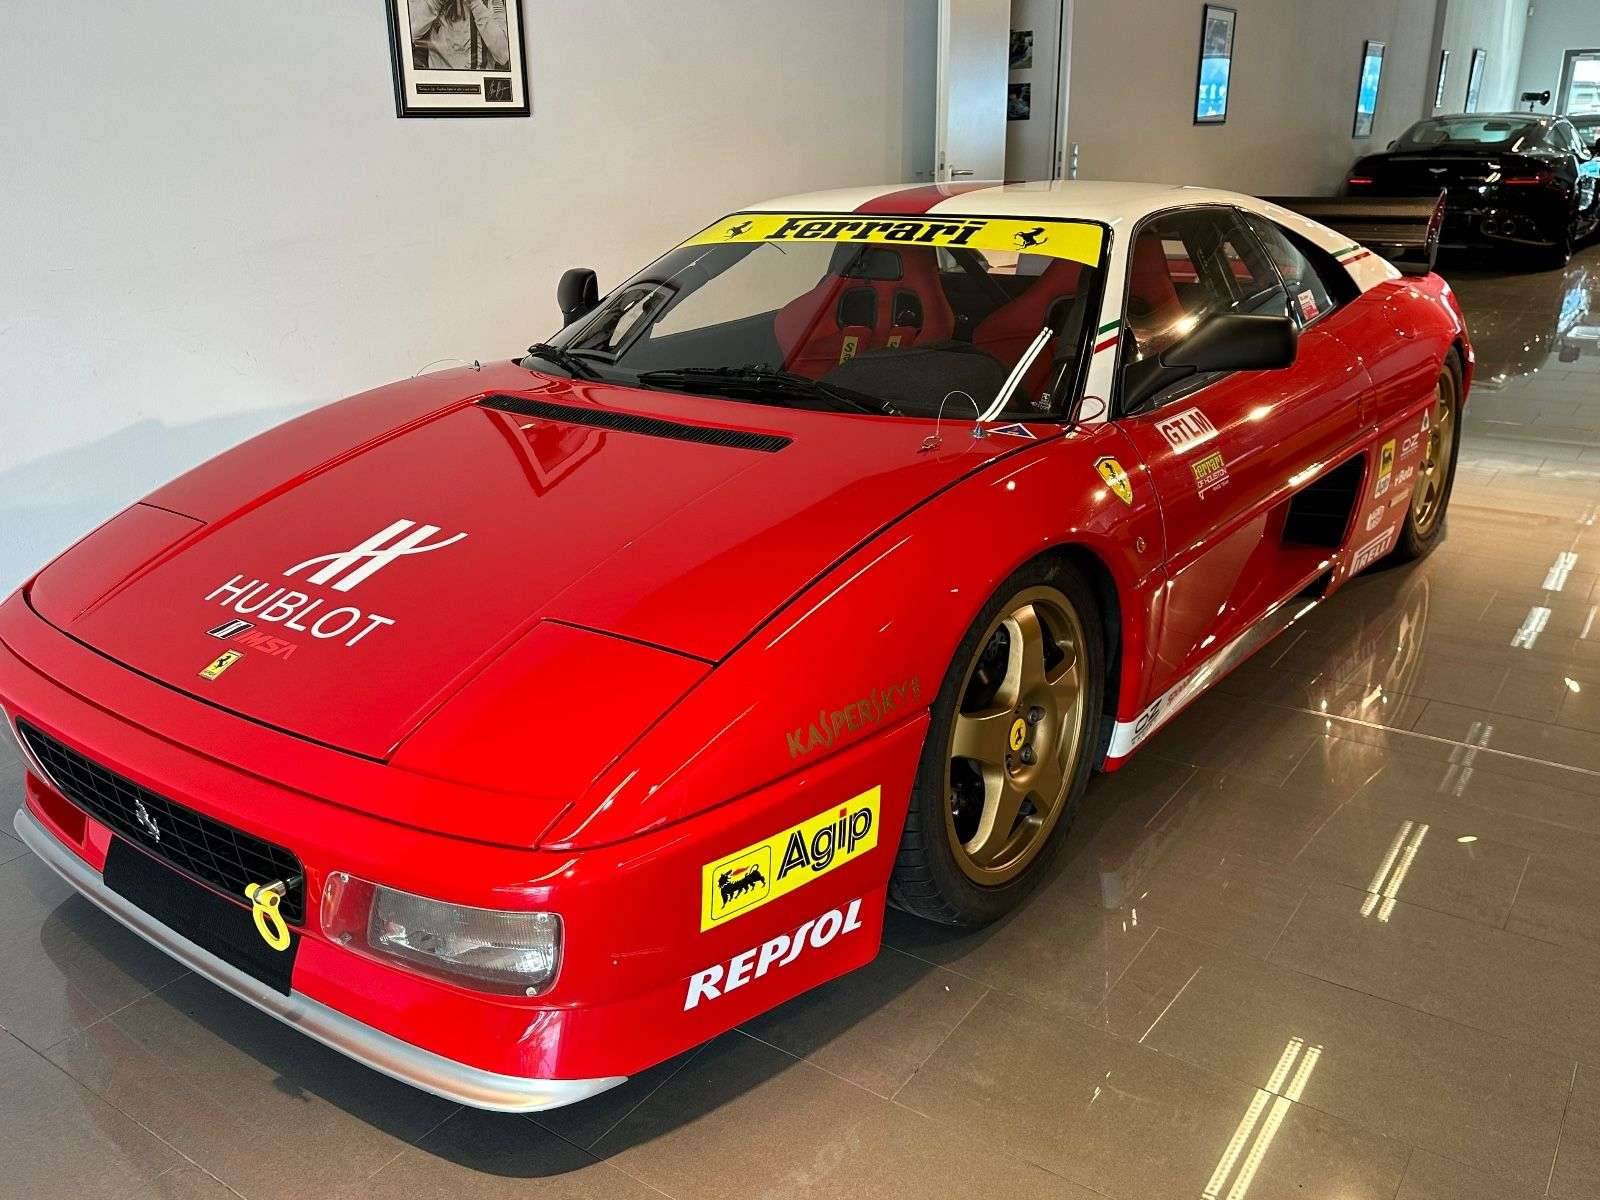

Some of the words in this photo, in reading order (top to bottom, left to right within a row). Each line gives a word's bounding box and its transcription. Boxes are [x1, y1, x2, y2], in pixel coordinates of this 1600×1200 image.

[764, 216, 988, 245] Ferrari
[1161, 410, 1214, 447] GTLM
[1191, 450, 1225, 481] Ferrari
[1348, 525, 1395, 577] PIRELLI
[204, 574, 396, 647] HUBLOT
[785, 679, 910, 759] KASPERSKY
[776, 807, 873, 881] Agip
[683, 898, 863, 1012] REPSOL
